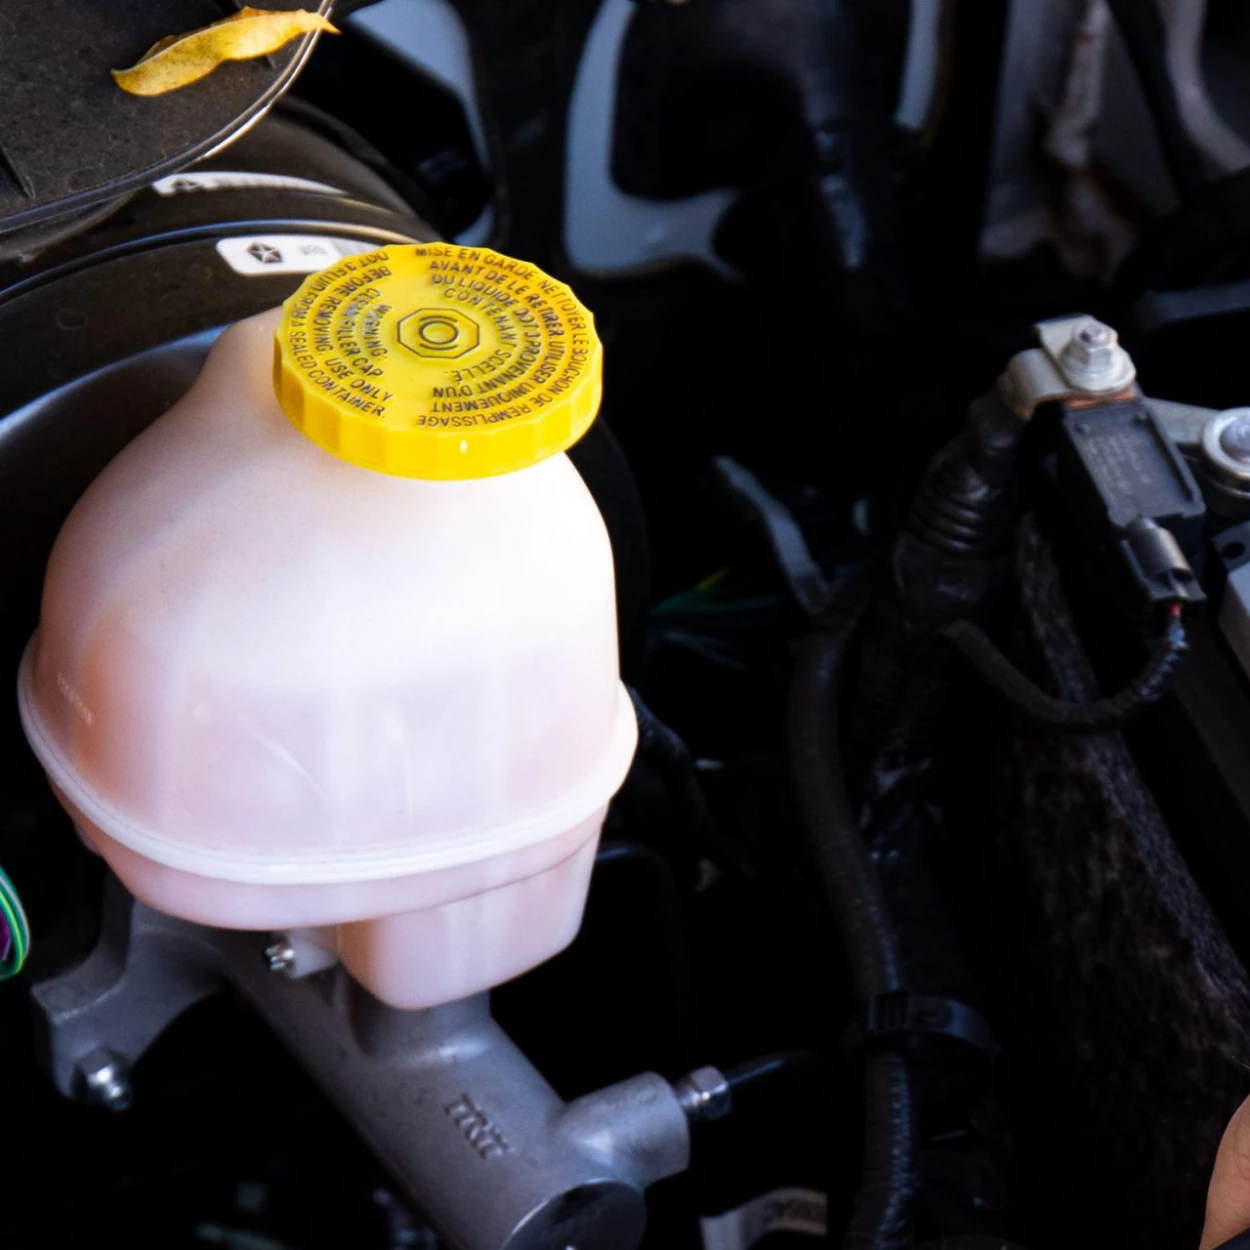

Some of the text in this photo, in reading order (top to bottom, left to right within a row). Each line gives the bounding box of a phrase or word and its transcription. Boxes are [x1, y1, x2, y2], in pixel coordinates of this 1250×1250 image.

[359, 250, 389, 267] DOT
[415, 247, 454, 257] MISE
[458, 248, 481, 261] EN
[344, 262, 357, 271] 3
[430, 260, 485, 275] AVANT
[485, 270, 509, 284] DE
[311, 267, 348, 292] FLUID
[334, 265, 392, 297] BEFORE
[432, 273, 455, 285] DU
[507, 280, 531, 294] LE
[292, 290, 319, 318] FROM
[459, 277, 519, 307] LIQUIDE
[537, 280, 587, 330] NETTOYER
[444, 288, 517, 347] CONTENANT
[513, 307, 539, 329] DOT
[289, 330, 317, 369] SEALED
[337, 319, 361, 356] FILLER
[352, 357, 384, 376] CAP
[572, 333, 589, 345] LE
[325, 357, 354, 379] USE
[477, 340, 542, 394] PROVENANT
[530, 341, 565, 384] UTILISER
[547, 347, 589, 395] BOUCHON
[350, 378, 394, 402] ONLY
[431, 381, 536, 412] UNIQUEMENT
[433, 385, 473, 398] D'UN
[529, 392, 553, 407] DE
[418, 403, 532, 427] REMPLISSAGE
